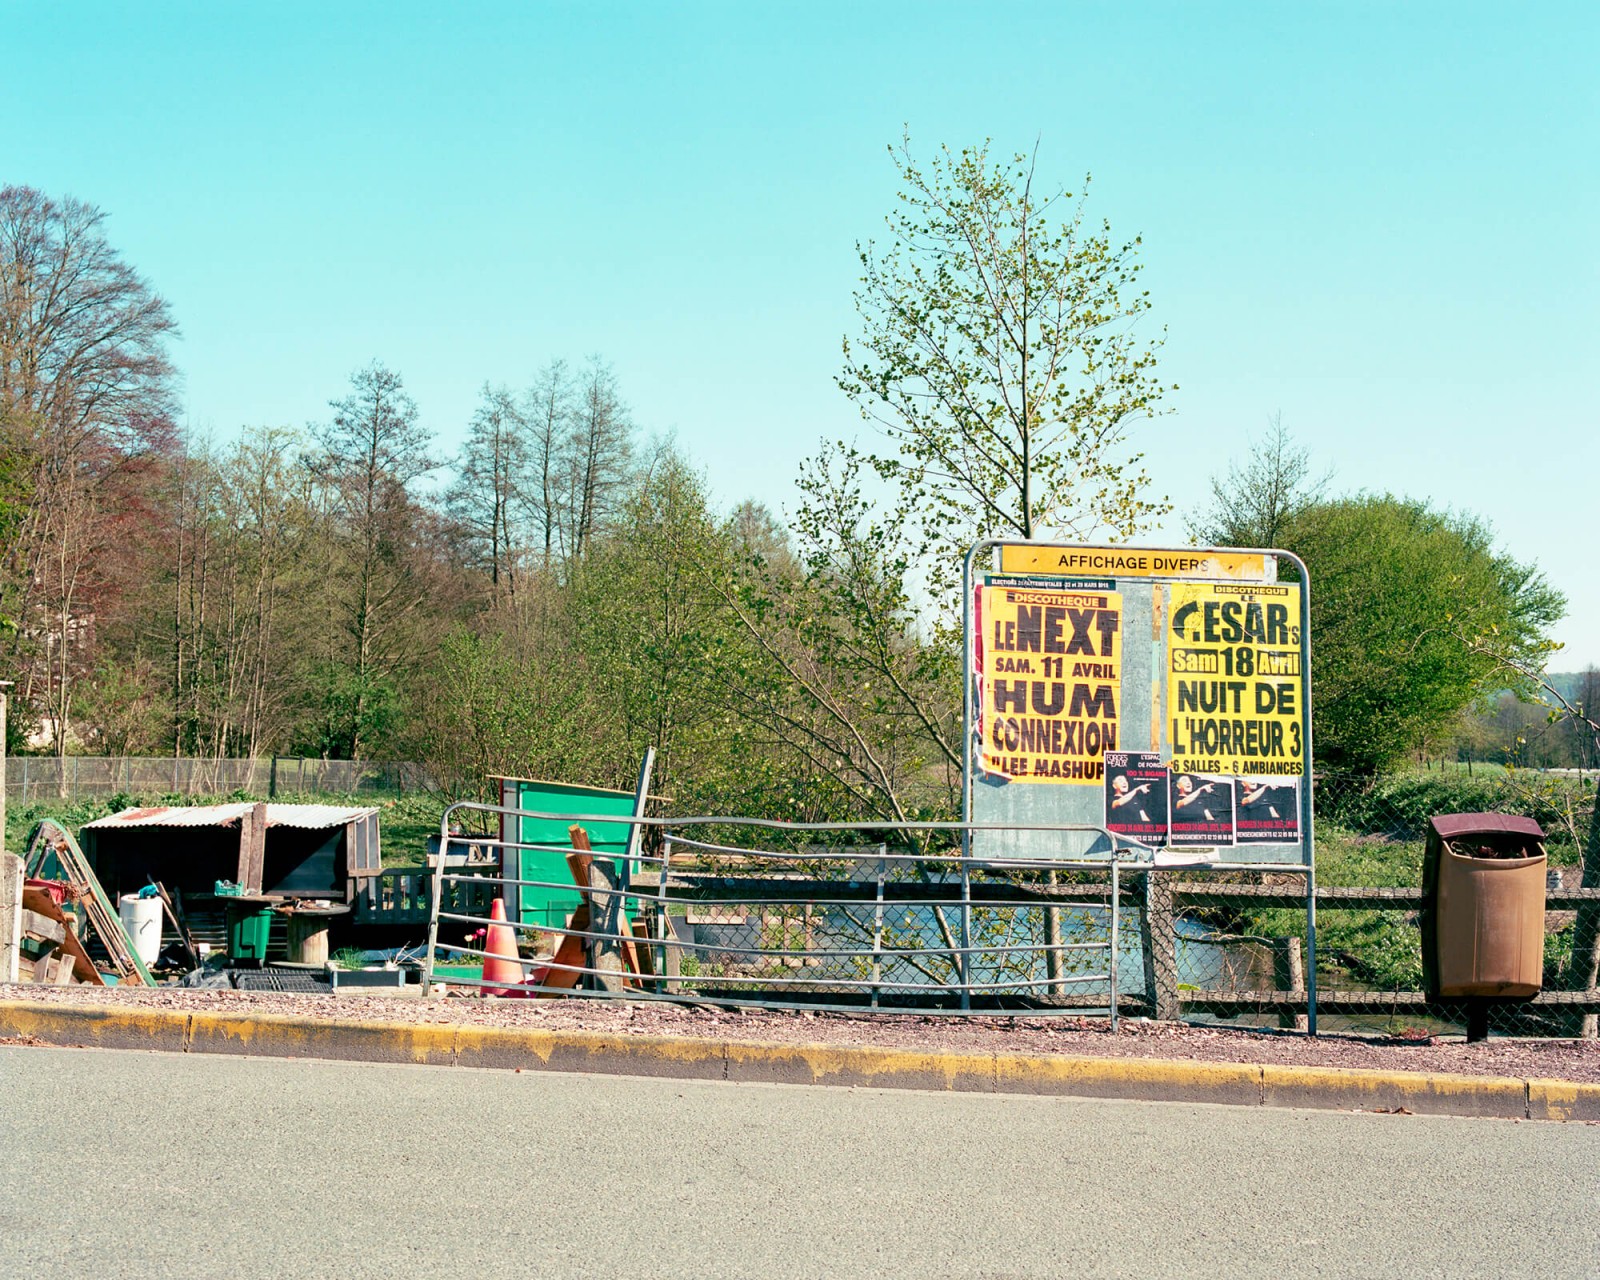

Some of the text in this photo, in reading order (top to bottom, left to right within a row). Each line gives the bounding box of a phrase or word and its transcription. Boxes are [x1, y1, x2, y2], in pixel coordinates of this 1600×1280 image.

[1058, 554, 1209, 572] AFFICHAGE DIVERS
[1014, 593, 1100, 608] DISCOTHEQUE
[1215, 586, 1287, 595] DISCOTHEQUE
[995, 605, 1119, 657] LE NEXT
[995, 656, 1116, 679] SAM. 11 AVRIL
[1173, 647, 1299, 677] Sam 18 Avril
[993, 679, 1117, 719] HUM
[1178, 680, 1295, 715] NUIT DE
[992, 717, 1117, 757] CONNEXION
[1173, 716, 1301, 758] L'HORREUR 3
[1173, 759, 1180, 773] 6
[1183, 759, 1220, 773] SALLES
[1232, 760, 1239, 773] 6
[1242, 761, 1302, 775] AMBIANCES
